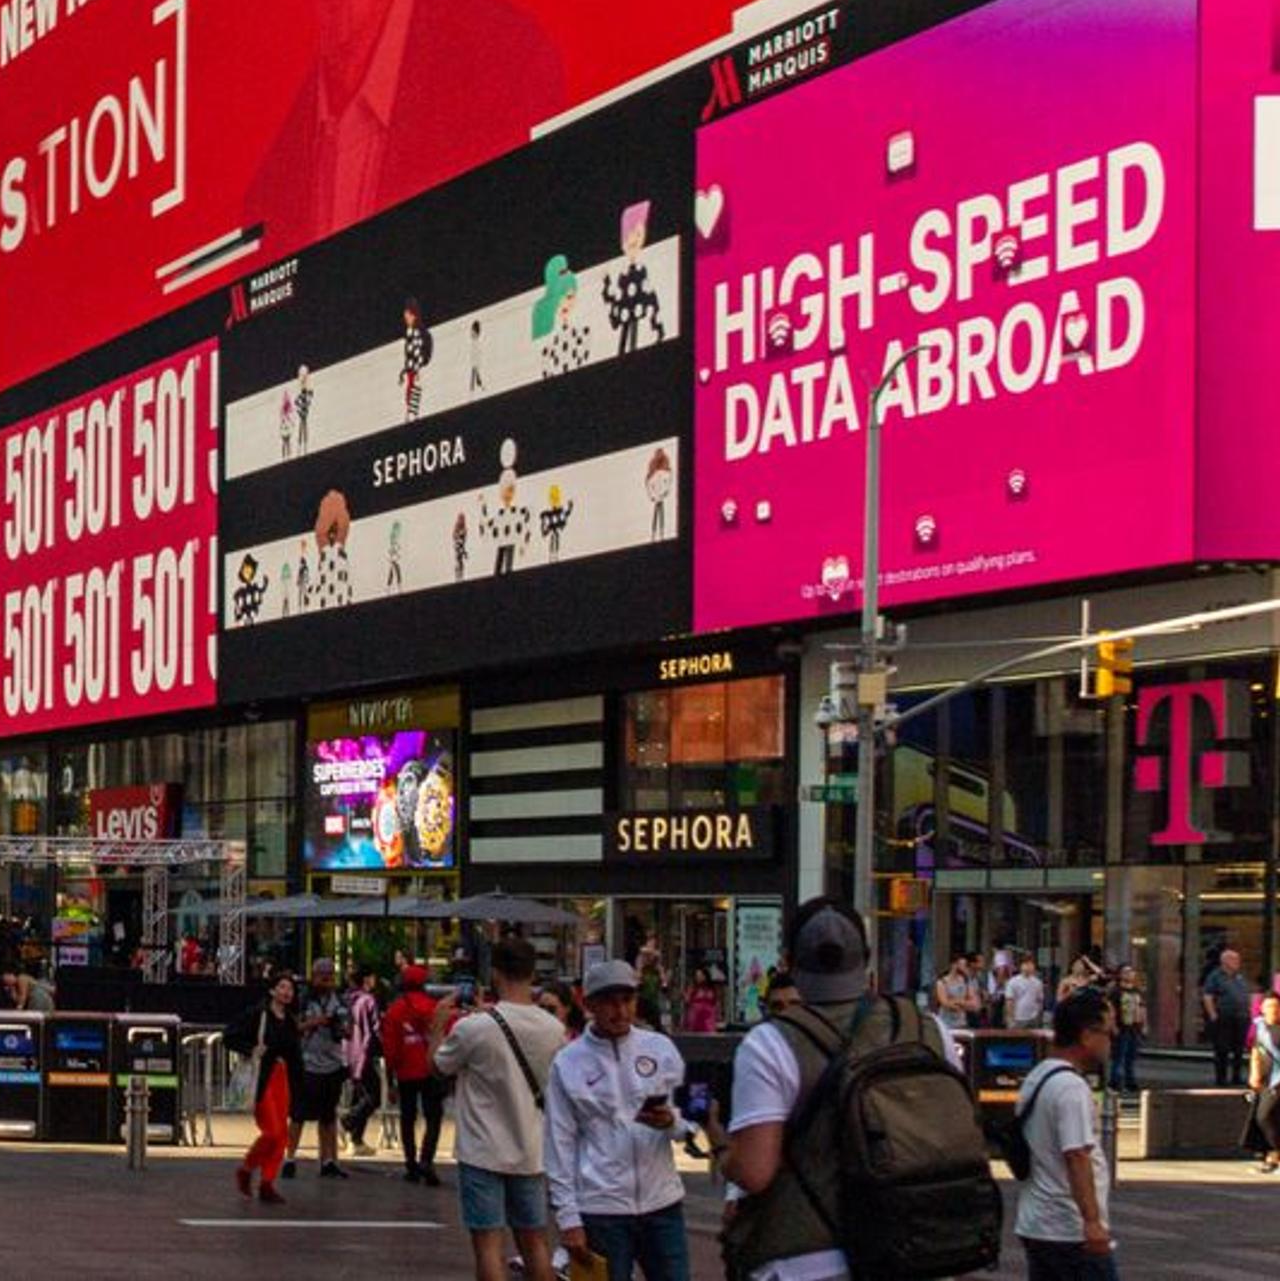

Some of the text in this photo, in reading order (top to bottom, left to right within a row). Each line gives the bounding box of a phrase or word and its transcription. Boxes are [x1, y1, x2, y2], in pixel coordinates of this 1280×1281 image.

[748, 9, 839, 66] MARRIOTT
[748, 41, 829, 94] MARQUIS
[251, 259, 298, 293] MARRIOTT
[715, 140, 1165, 375] HIGH-SPEED
[250, 282, 292, 314] MARQUIS
[725, 276, 1146, 461] DATA ABROAD
[5, 353, 200, 561] 501 501 501
[373, 436, 465, 488] SEPHORA
[3, 539, 199, 718] 501 501 501
[659, 652, 733, 679] SEPHORA
[617, 814, 754, 854] SEPHORA
